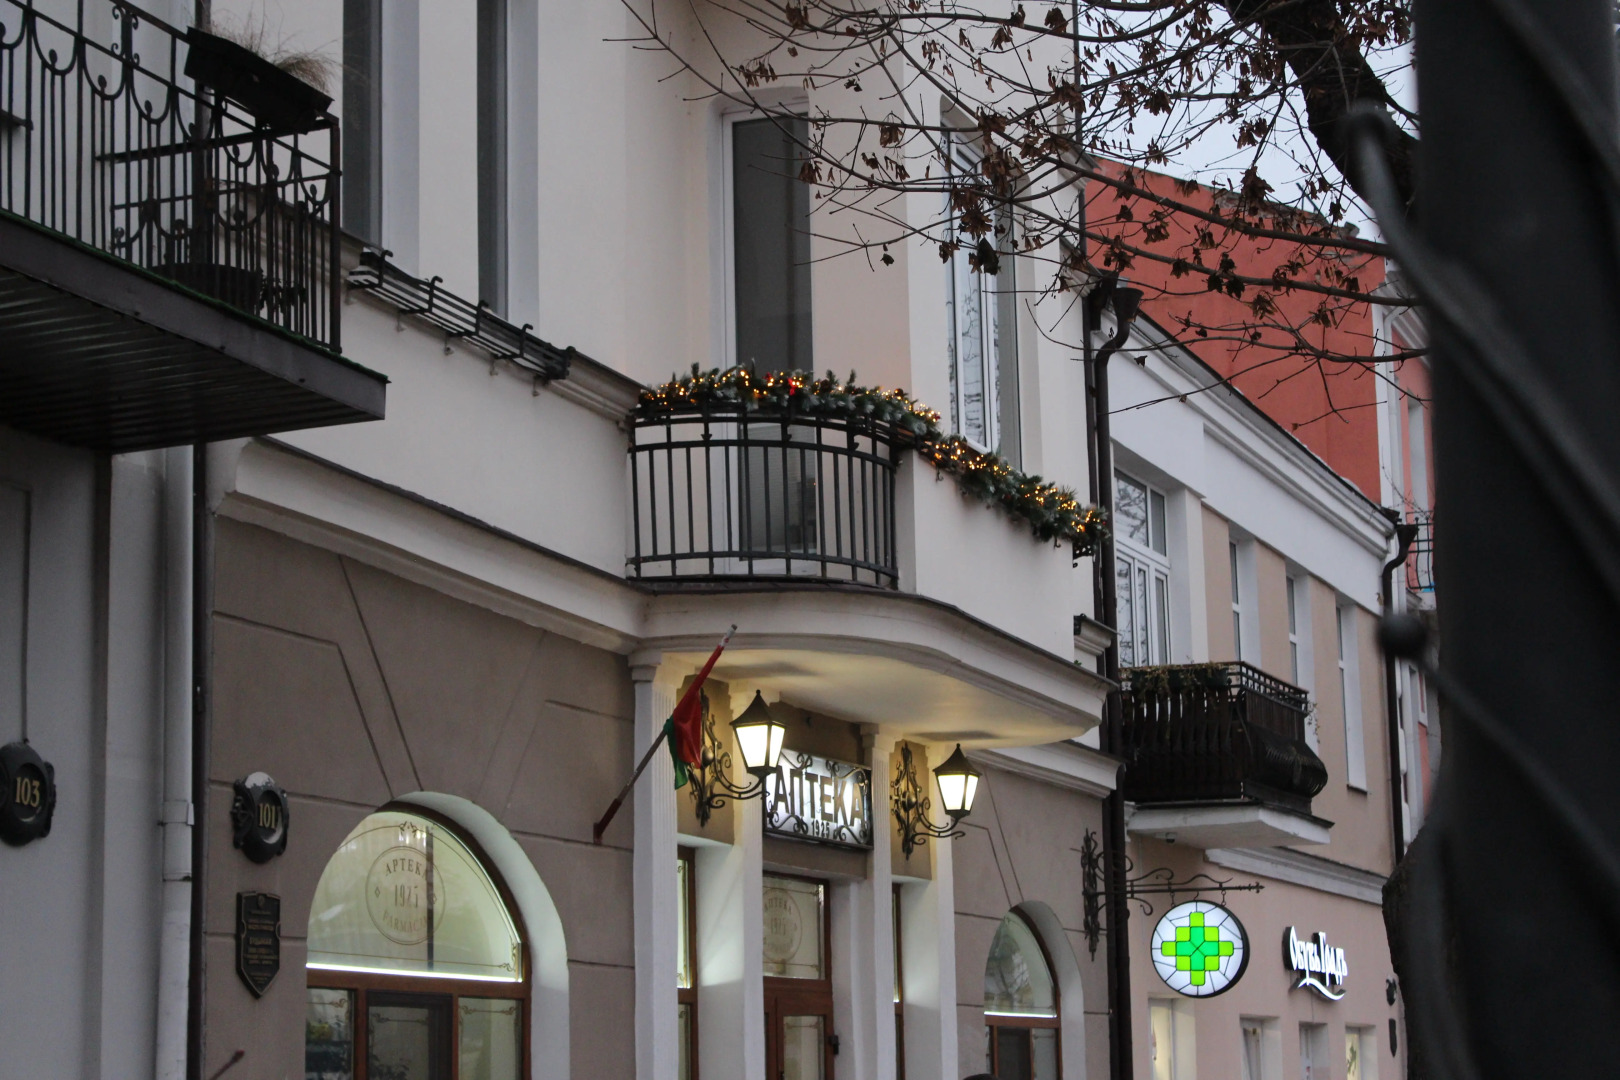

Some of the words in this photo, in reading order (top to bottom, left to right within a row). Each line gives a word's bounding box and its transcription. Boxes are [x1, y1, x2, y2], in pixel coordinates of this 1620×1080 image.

[15, 776, 40, 807] 103
[772, 765, 867, 829] АПТЕКА
[259, 803, 276, 829] 101
[811, 819, 830, 838] 1925
[385, 858, 430, 879] APTEK
